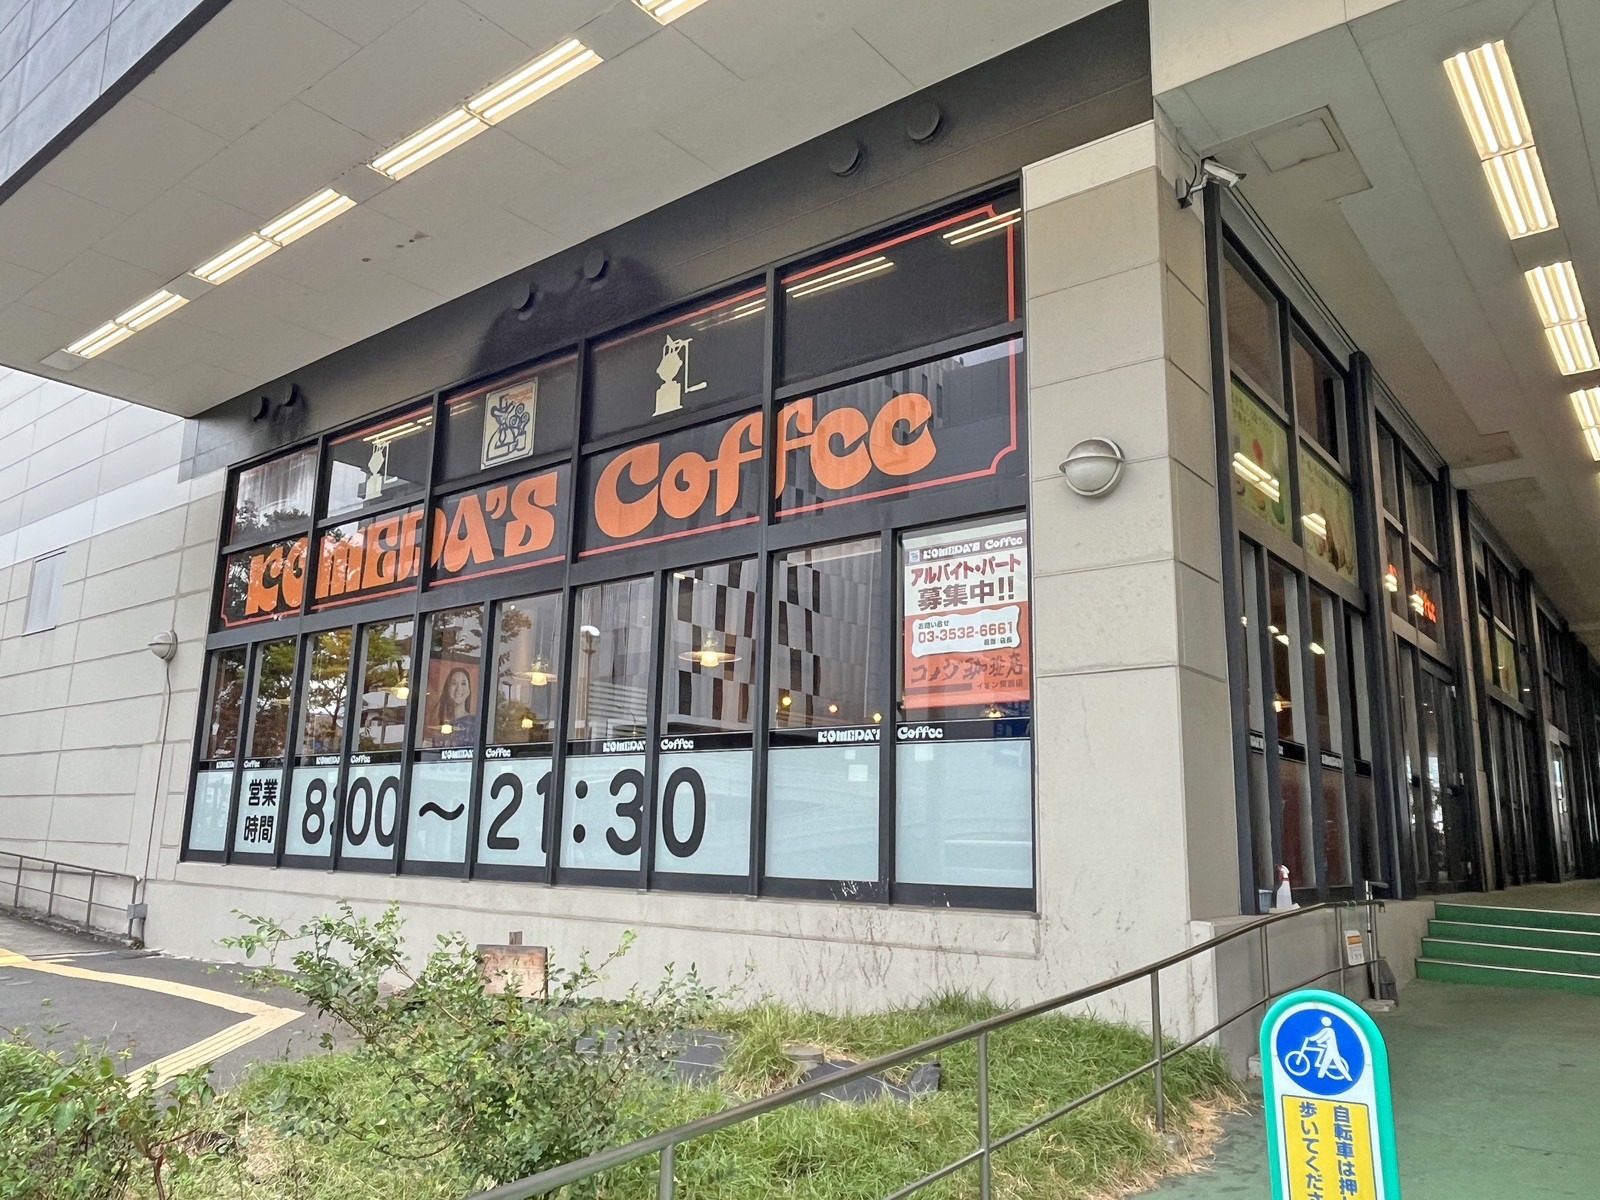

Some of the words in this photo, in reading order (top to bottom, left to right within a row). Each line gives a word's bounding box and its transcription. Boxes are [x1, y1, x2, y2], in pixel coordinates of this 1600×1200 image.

[245, 472, 558, 616] KOMEDA'S
[594, 392, 937, 538] Coffee
[923, 541, 980, 560] KOMEDA'S
[984, 536, 1023, 550] Coffee
[911, 553, 1021, 586] アルバイト・パート
[918, 621, 1013, 643] 03-3532-6661
[660, 738, 694, 750] Coffee
[897, 725, 943, 739] Coffee
[485, 747, 511, 758] Coffee
[248, 778, 278, 807] 営業
[243, 814, 274, 844] 時間
[1333, 1105, 1358, 1200] 自転車は押
